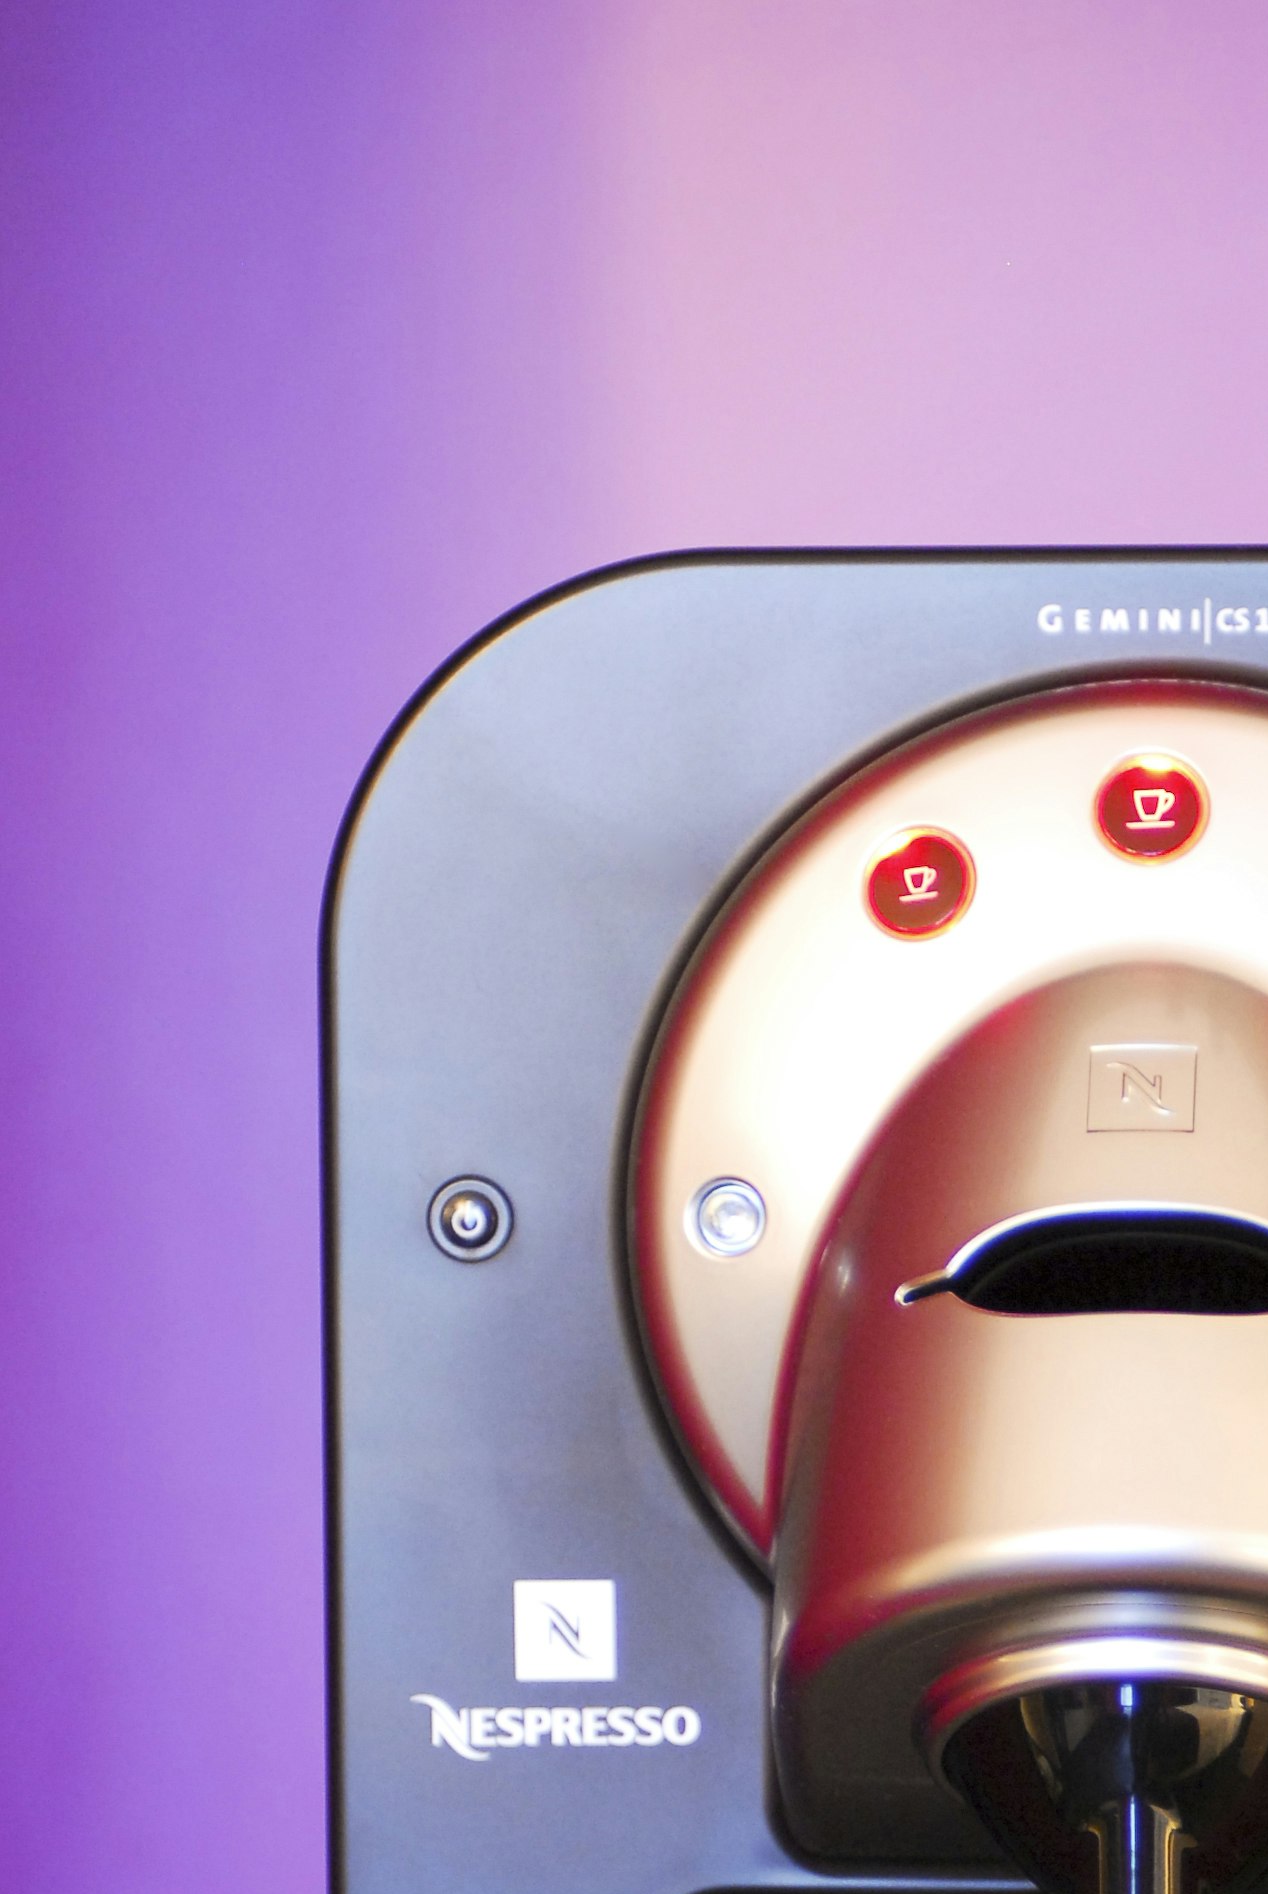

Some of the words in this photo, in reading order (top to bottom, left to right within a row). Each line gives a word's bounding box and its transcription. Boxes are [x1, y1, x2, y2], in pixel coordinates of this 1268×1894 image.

[1037, 604, 1201, 633] GEMINI
[1216, 607, 1251, 633] CS
[409, 1693, 701, 1761] NESPRESSO
